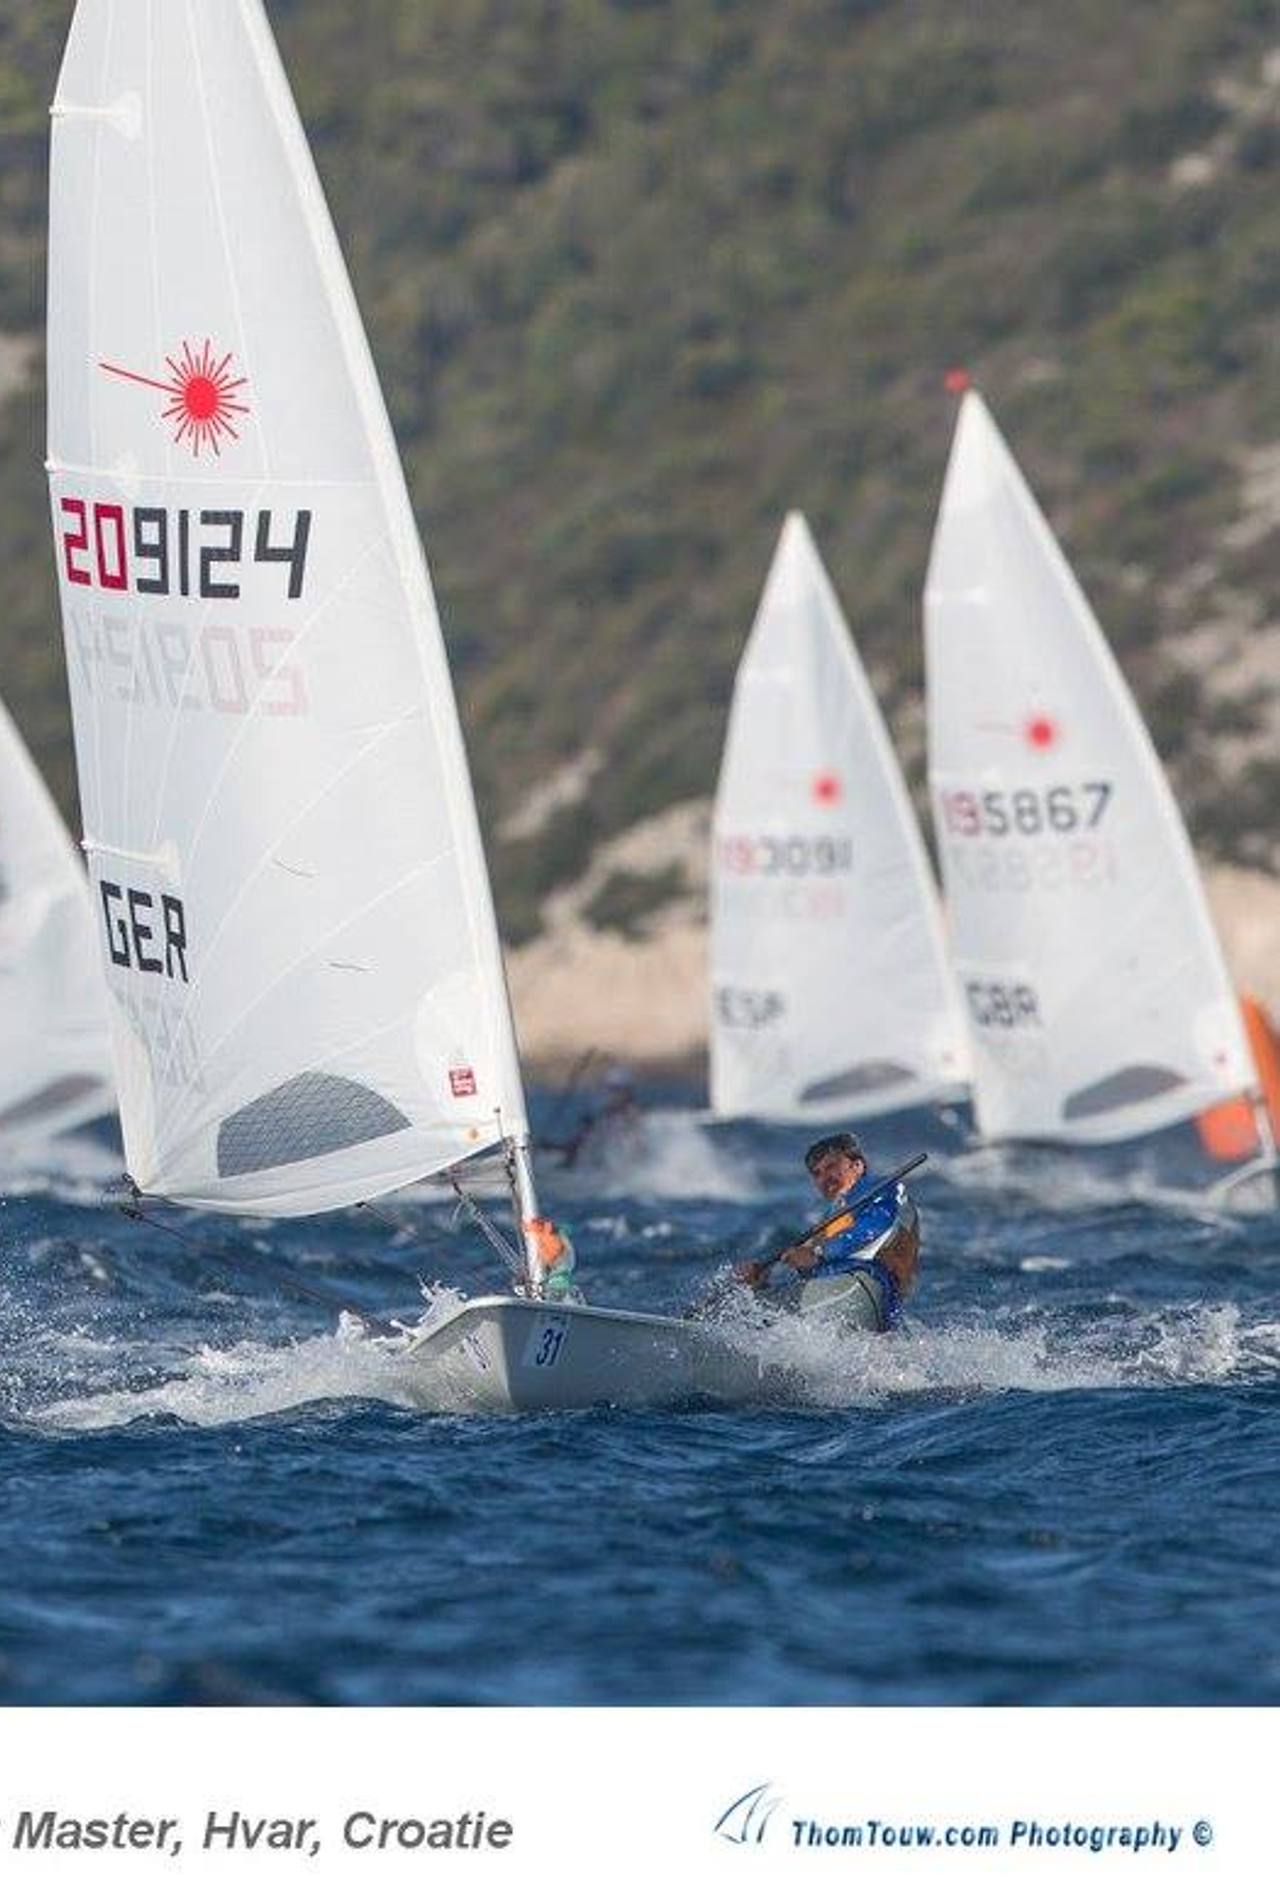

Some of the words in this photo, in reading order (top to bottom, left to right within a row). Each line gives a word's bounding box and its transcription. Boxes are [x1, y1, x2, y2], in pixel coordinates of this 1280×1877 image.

[61, 497, 312, 599] 209124
[942, 783, 1112, 837] 195867
[100, 879, 190, 983] GER
[966, 980, 1040, 1029] GBR
[536, 1328, 563, 1366] 31
